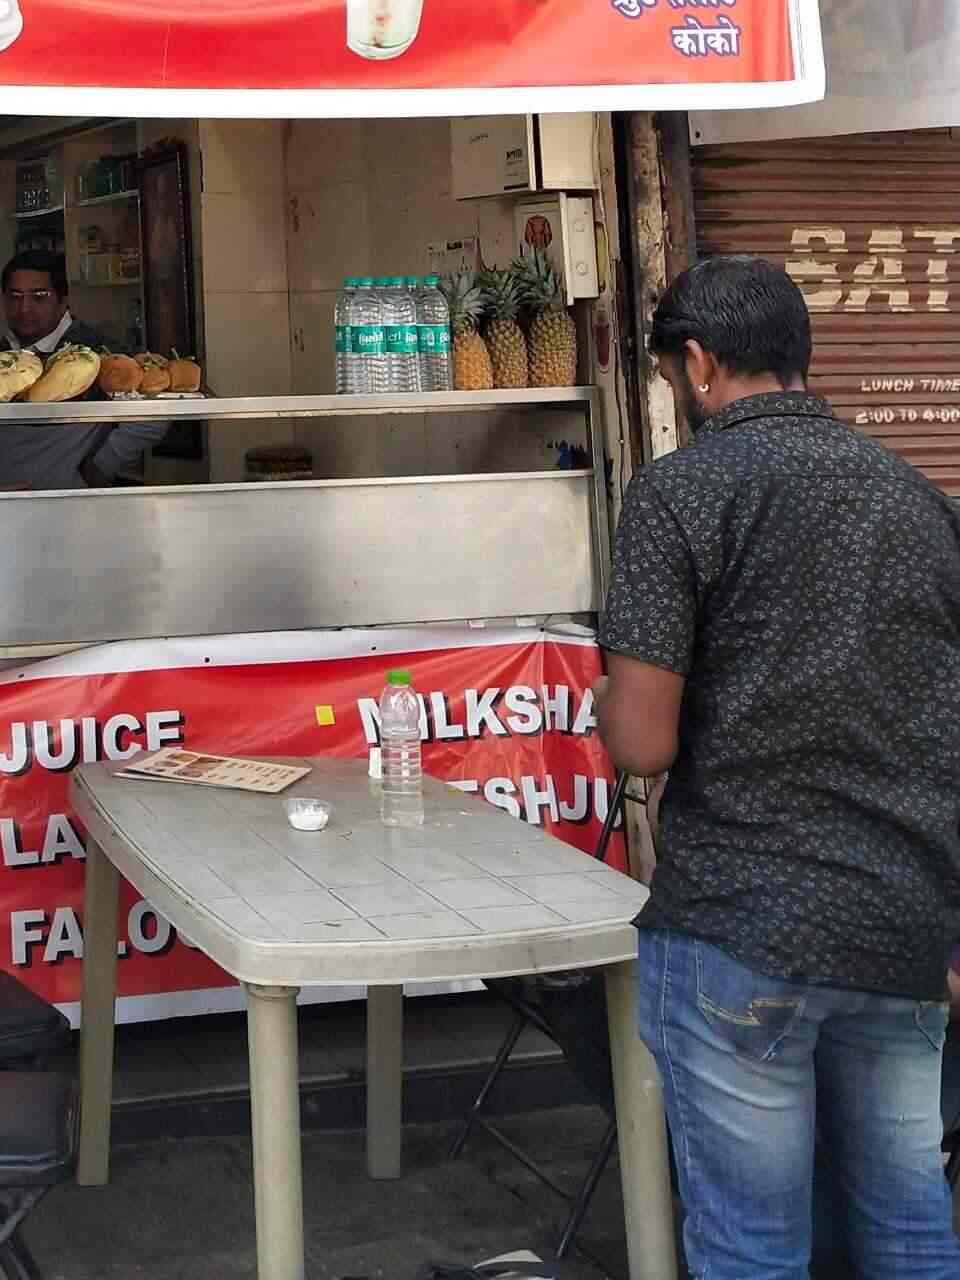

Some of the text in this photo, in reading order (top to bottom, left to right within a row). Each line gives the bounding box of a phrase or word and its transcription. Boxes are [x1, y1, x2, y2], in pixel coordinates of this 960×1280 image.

[671, 17, 741, 57] कोको
[860, 379, 960, 392] LUNCH TIME
[898, 409, 918, 422] TO
